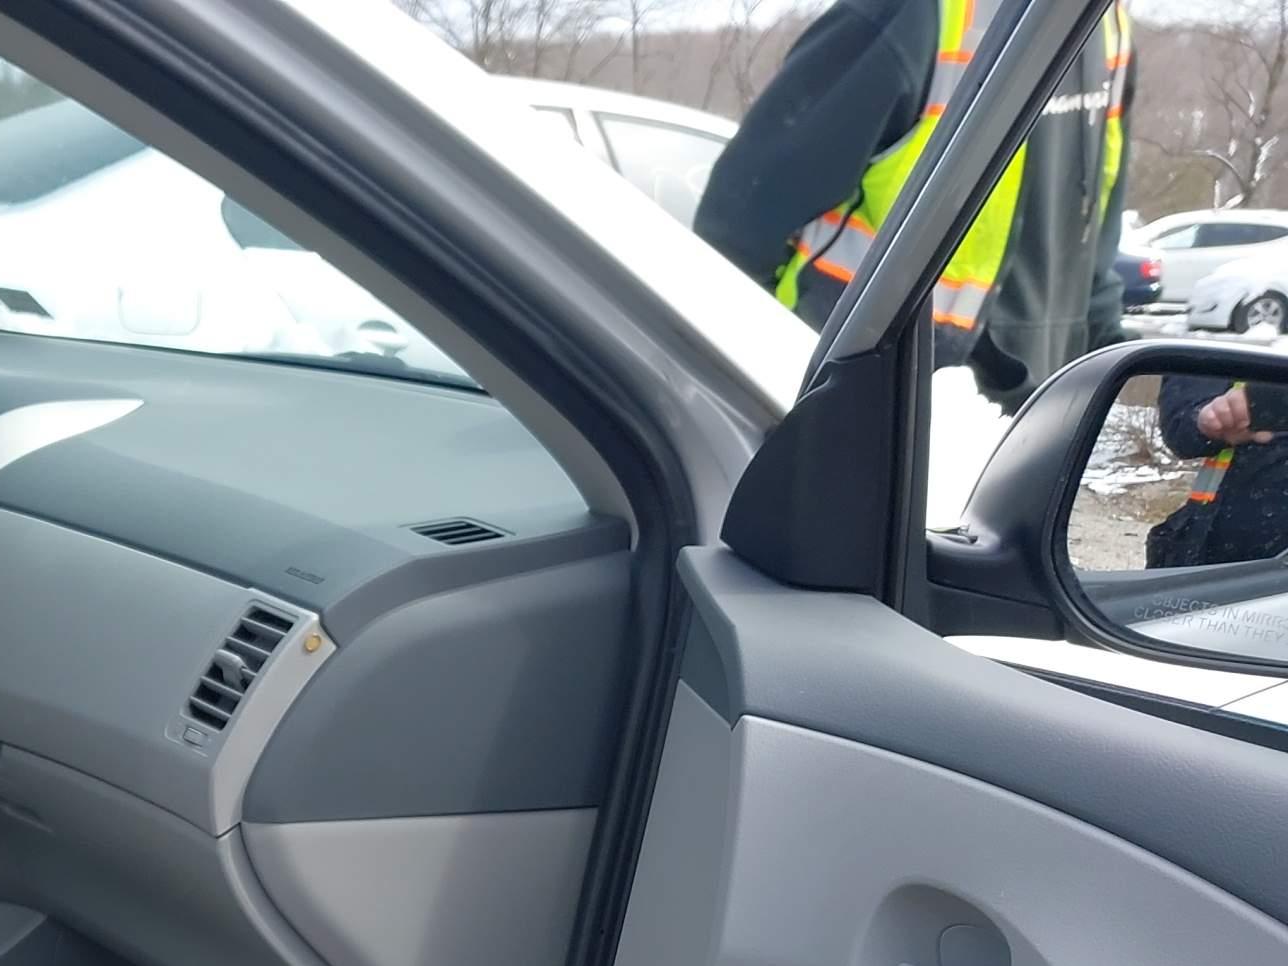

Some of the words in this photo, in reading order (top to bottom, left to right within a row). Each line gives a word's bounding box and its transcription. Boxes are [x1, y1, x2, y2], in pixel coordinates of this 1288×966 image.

[1152, 594, 1218, 616] OBJECTS
[1222, 606, 1240, 620] IN
[1134, 606, 1193, 628] CLOSER
[1199, 617, 1240, 637] THAN
[1244, 625, 1285, 644] THEY
